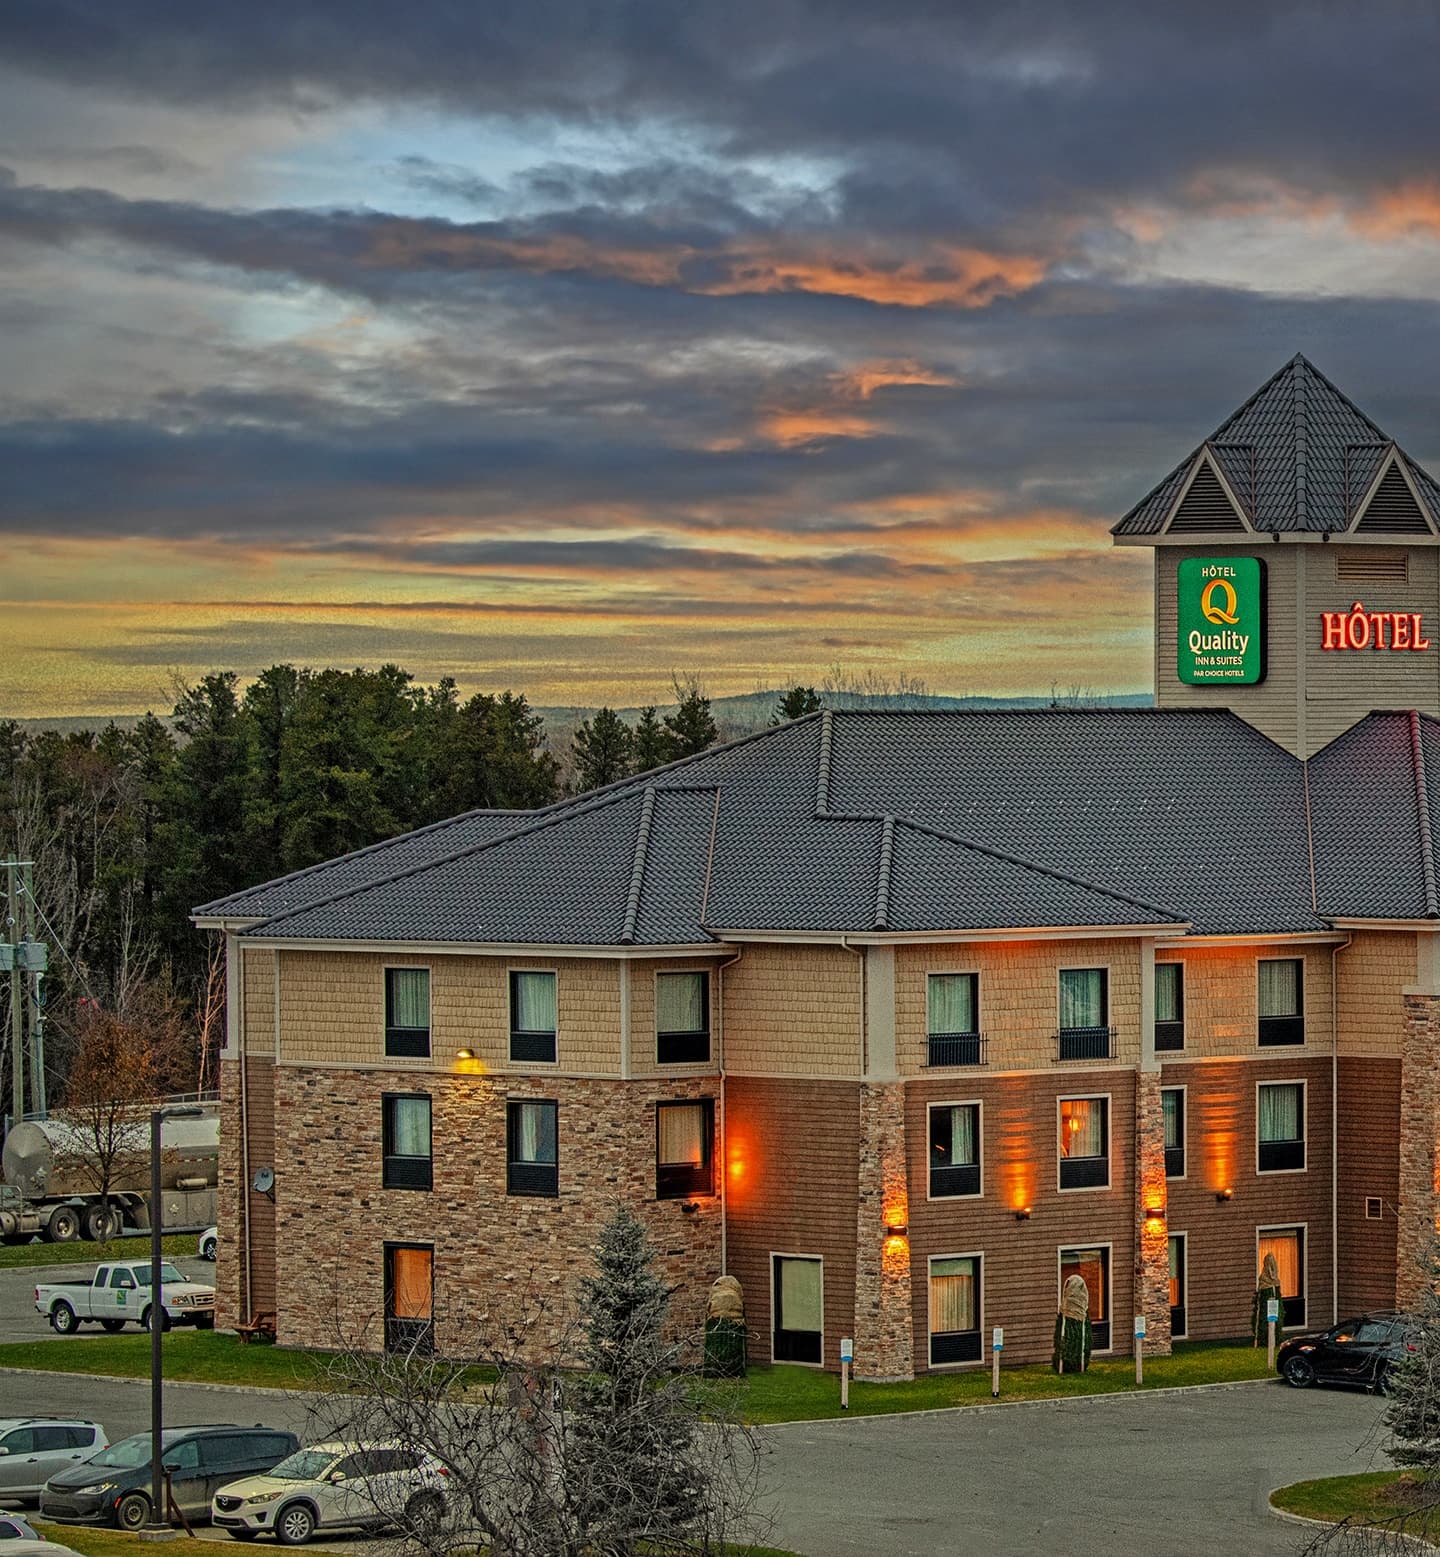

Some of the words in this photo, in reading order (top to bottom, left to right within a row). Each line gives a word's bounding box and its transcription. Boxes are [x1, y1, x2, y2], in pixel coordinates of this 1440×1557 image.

[1201, 564, 1236, 577] HÔTEL
[1322, 601, 1430, 650] HÔTEL
[1188, 630, 1249, 655] Quality
[1195, 656, 1209, 665] INN
[1216, 656, 1243, 665] SUITES
